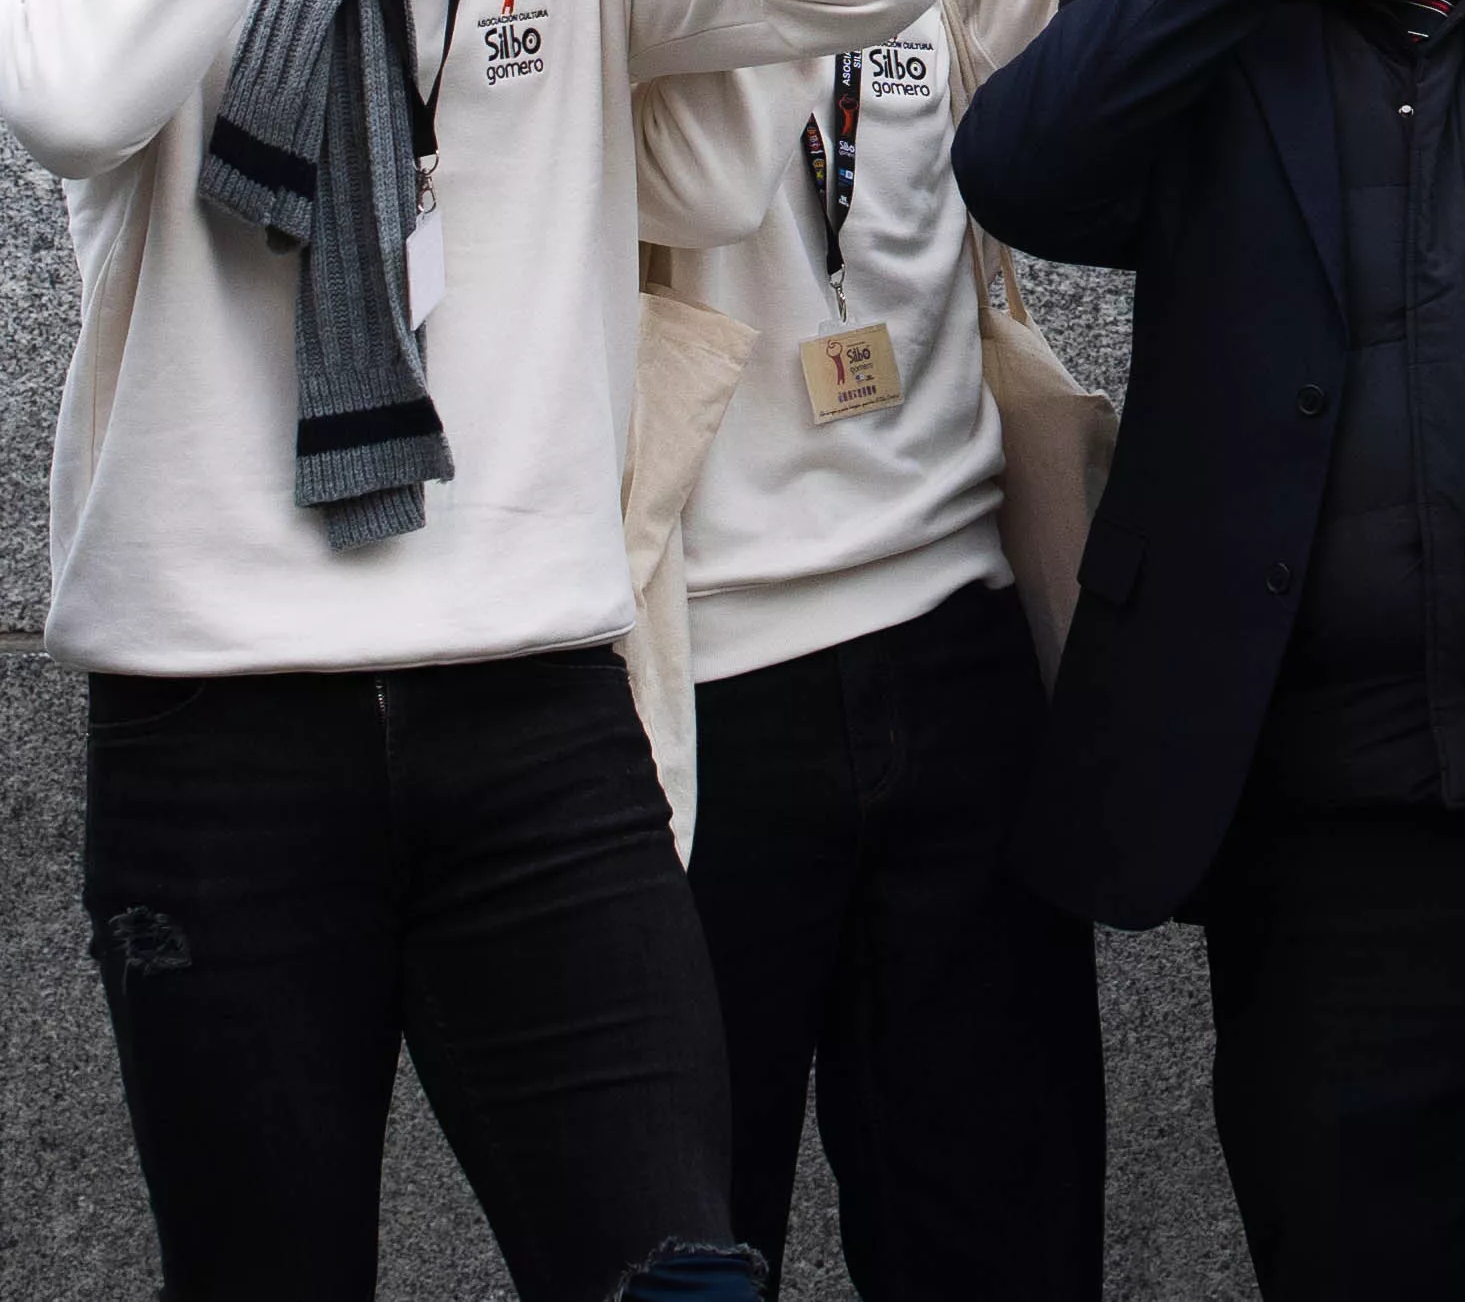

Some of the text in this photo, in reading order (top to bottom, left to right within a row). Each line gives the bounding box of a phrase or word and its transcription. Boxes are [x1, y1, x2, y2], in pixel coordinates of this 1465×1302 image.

[484, 24, 542, 62] Silbo
[486, 58, 544, 86] gomero
[869, 48, 927, 81] Silbo
[872, 81, 931, 98] gomero
